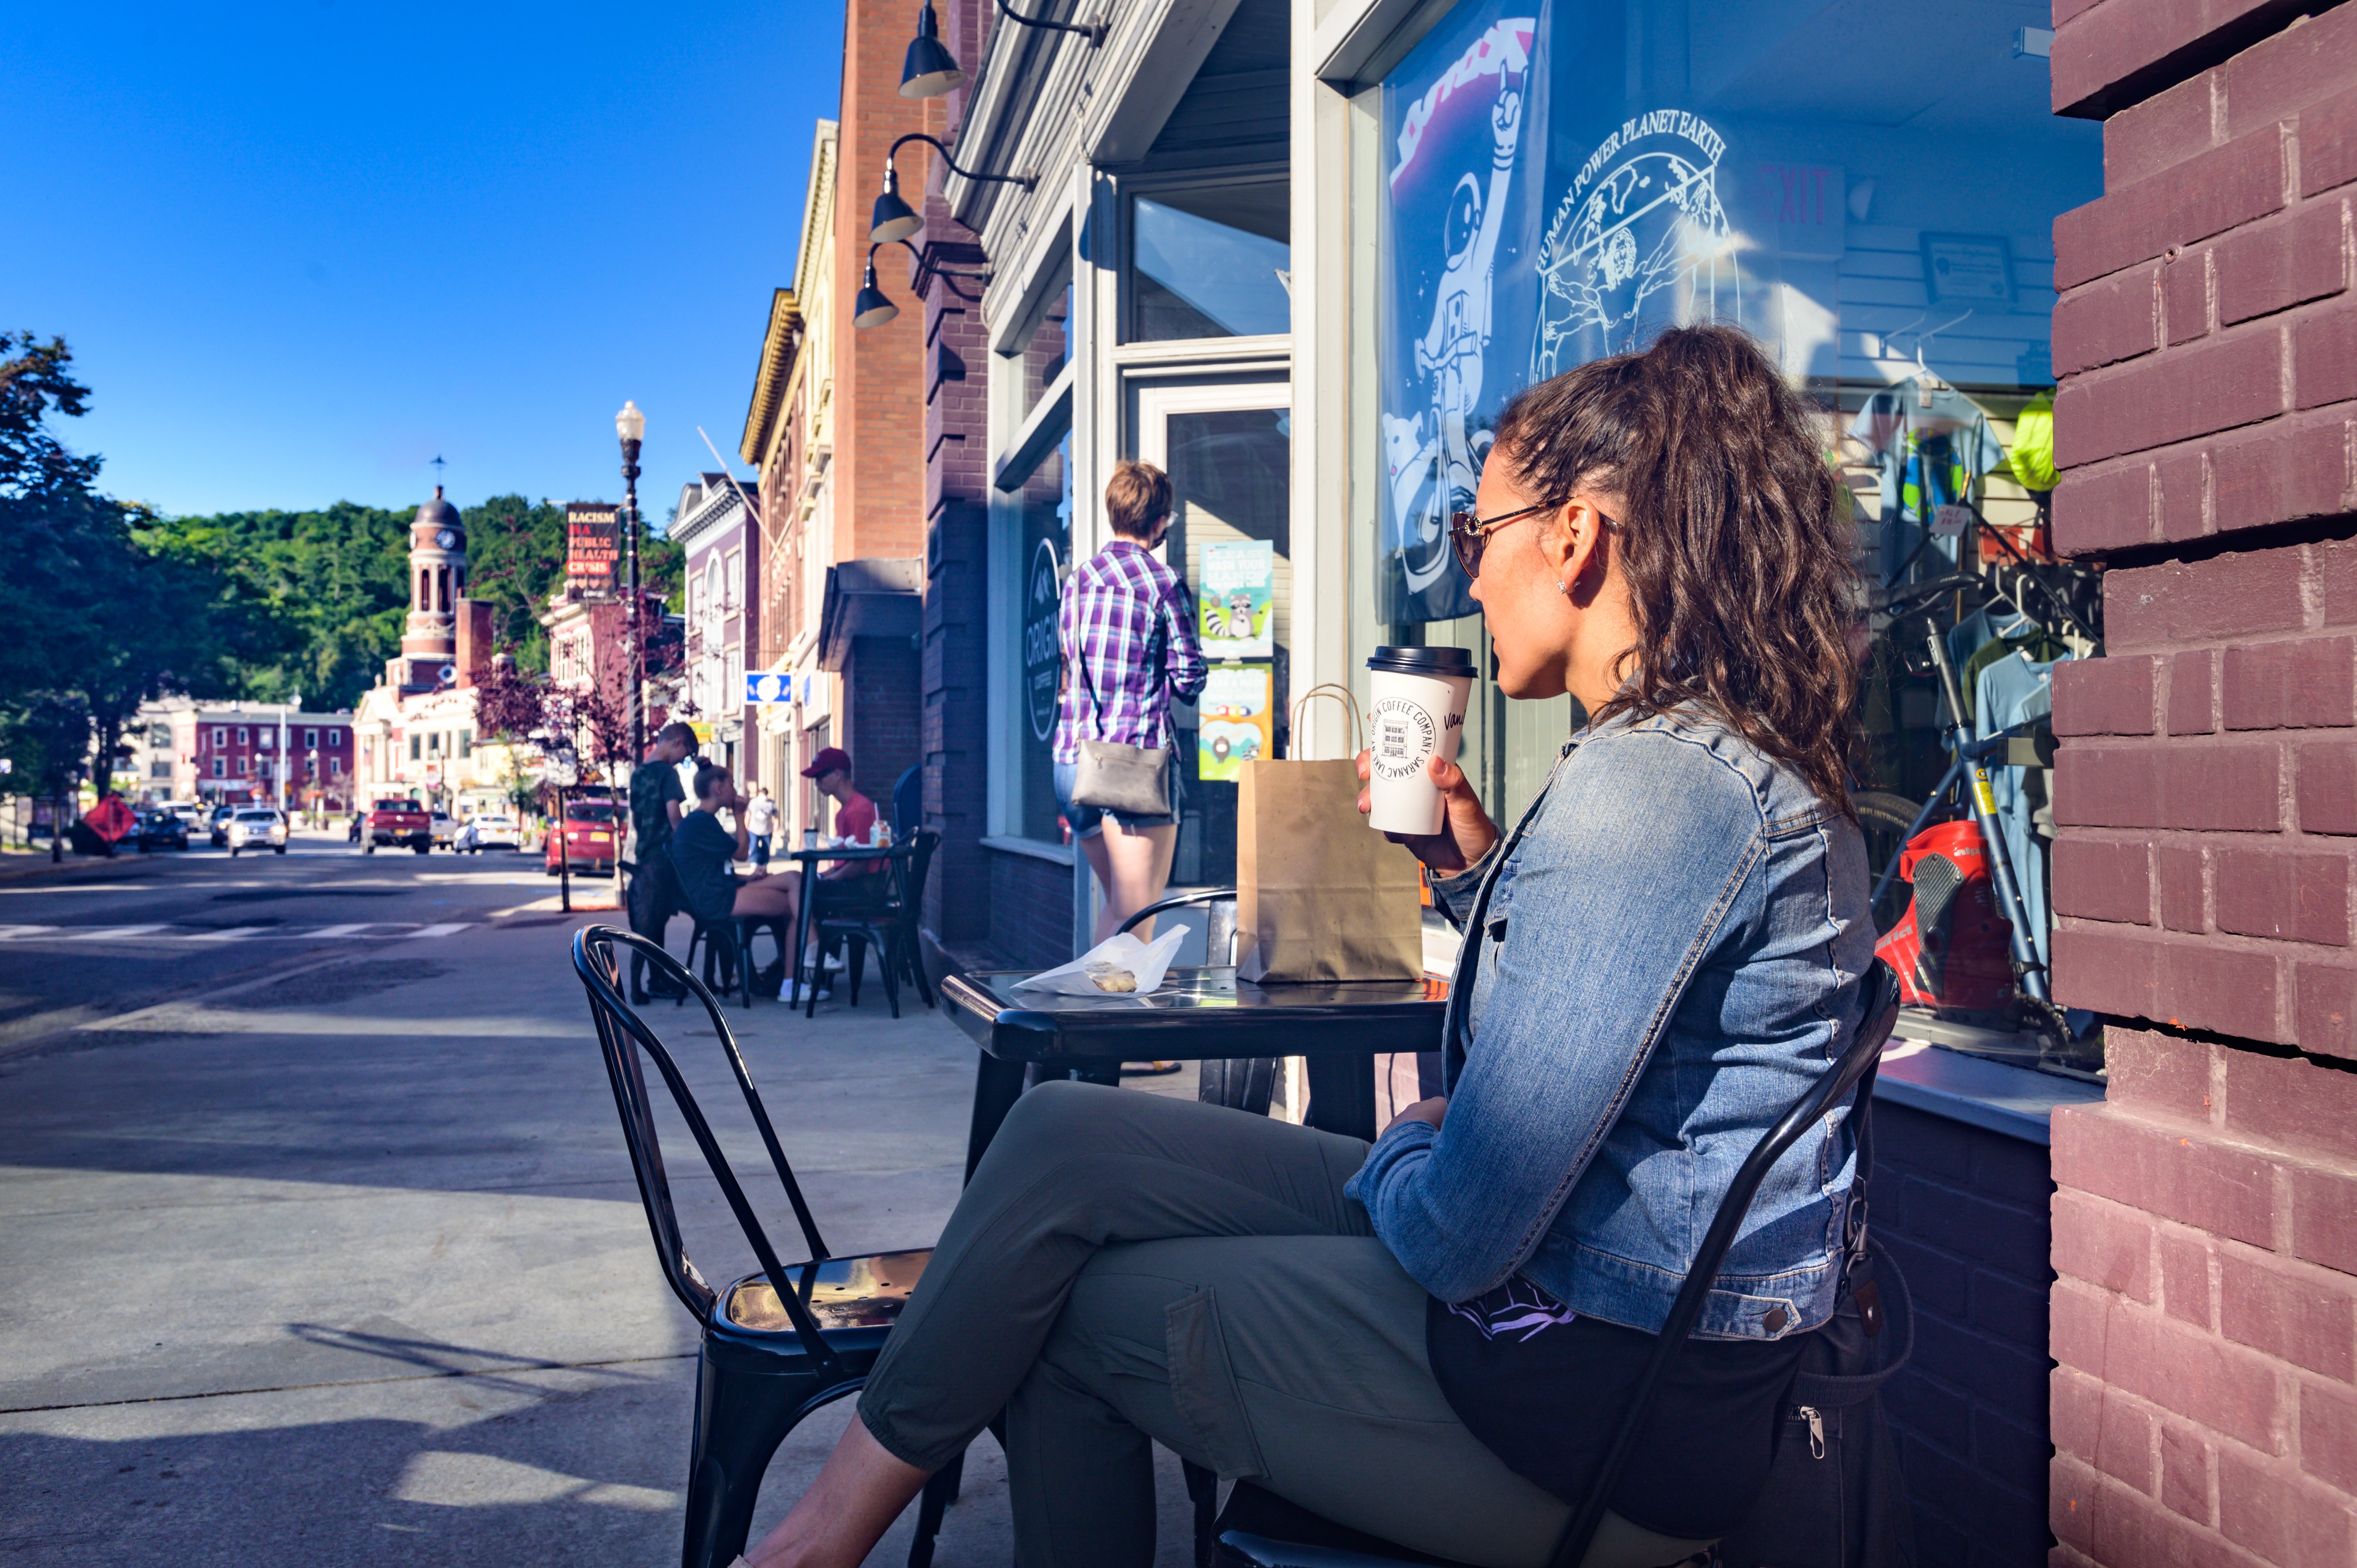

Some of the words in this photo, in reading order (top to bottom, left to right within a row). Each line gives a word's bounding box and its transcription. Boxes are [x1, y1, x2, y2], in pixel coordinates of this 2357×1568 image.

[1535, 187, 1575, 275] HUMAN
[1574, 132, 1622, 196] POWER
[1622, 109, 1679, 145] PLANET
[1678, 112, 1726, 167] EARTH
[568, 512, 615, 523] RACISM
[582, 525, 591, 535] A
[568, 537, 612, 548] PUBLIC
[568, 549, 619, 561] HEALTH
[568, 562, 608, 573] CRISIS
[1207, 560, 1235, 571] WASH
[1238, 558, 1266, 570] YOUR
[1207, 570, 1266, 581] HANDS
[1026, 611, 1061, 667] ORIGIN
[1371, 707, 1382, 735] ORIGIN
[1382, 701, 1414, 715] COFFEE
[1413, 712, 1433, 755] COMPANY
[1371, 740, 1376, 752] NY
[1373, 754, 1385, 774] LAKE
[1387, 756, 1424, 778] SARANAC
